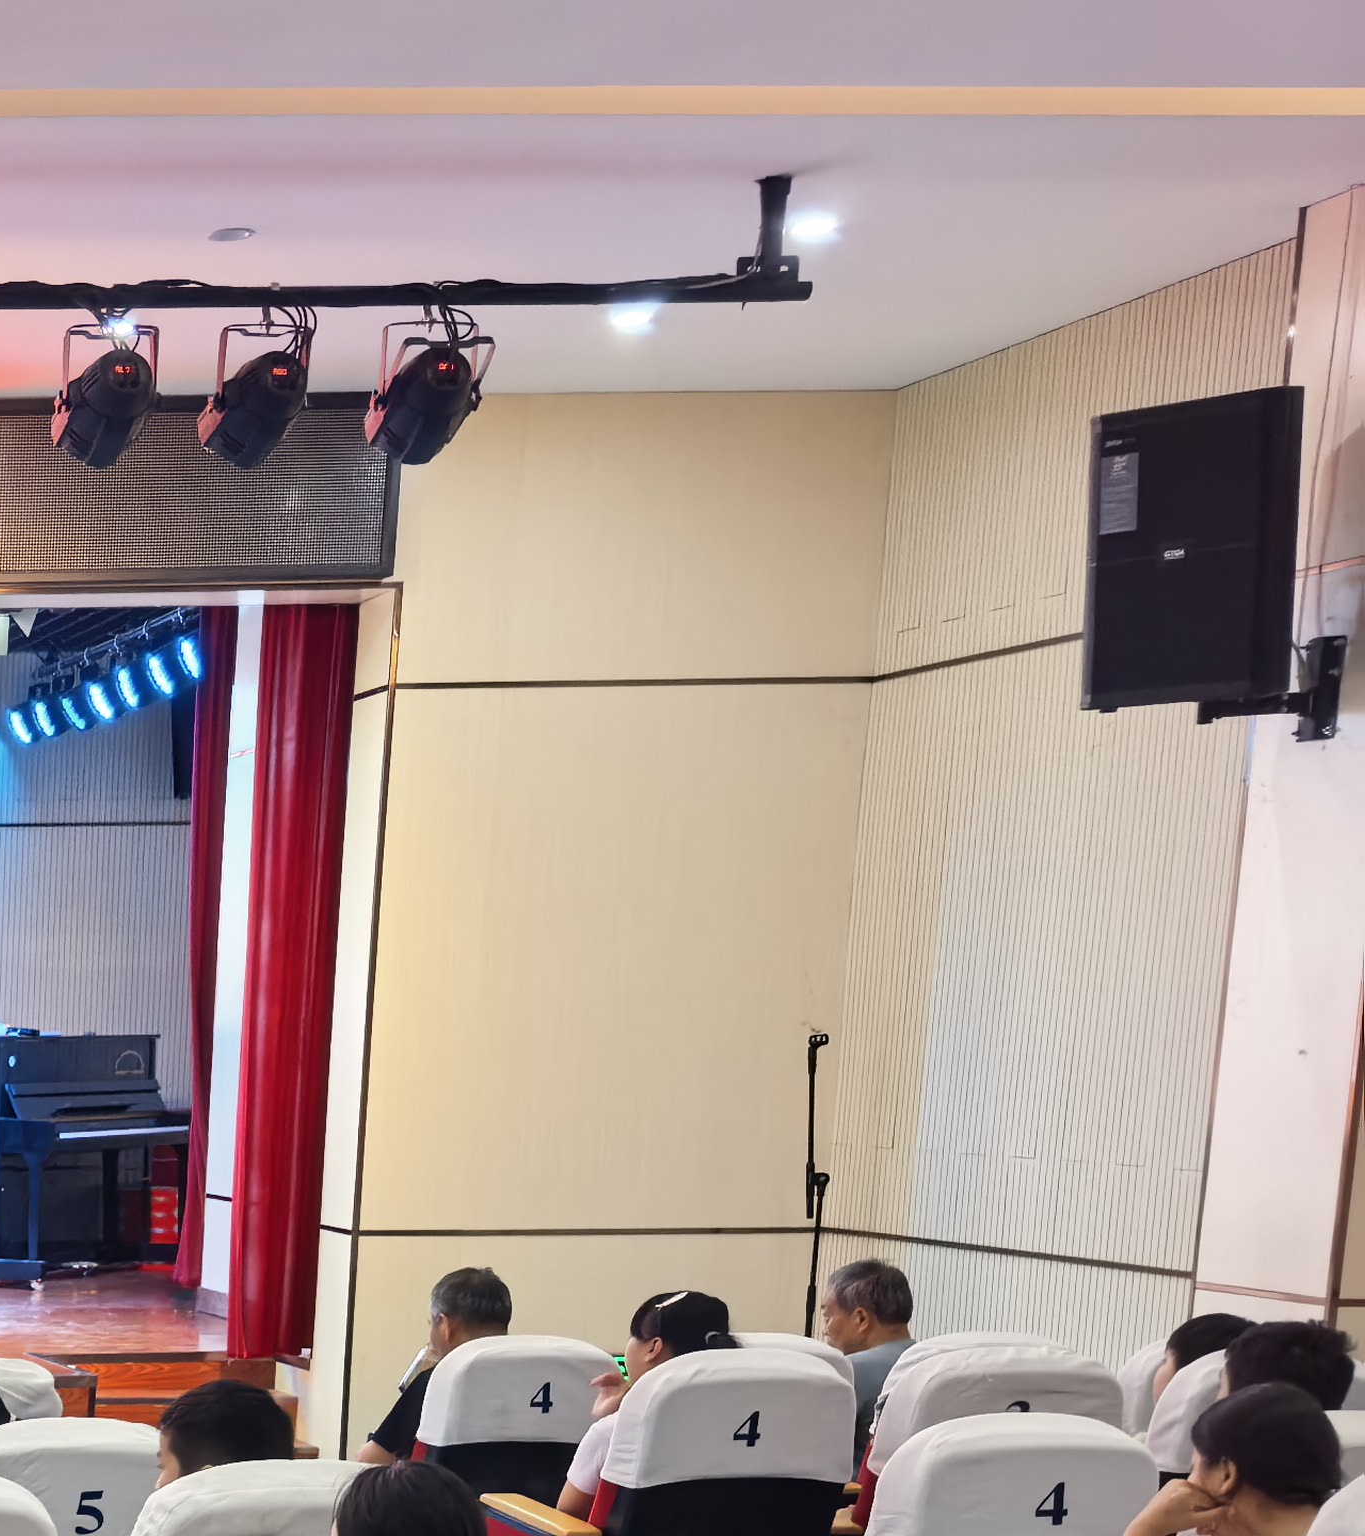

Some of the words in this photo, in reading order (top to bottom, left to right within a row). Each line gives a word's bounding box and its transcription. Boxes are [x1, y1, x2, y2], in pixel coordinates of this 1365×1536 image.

[529, 1381, 553, 1414] 4
[732, 1410, 761, 1448] 4
[74, 1490, 105, 1535] 5
[1035, 1481, 1069, 1526] 4
